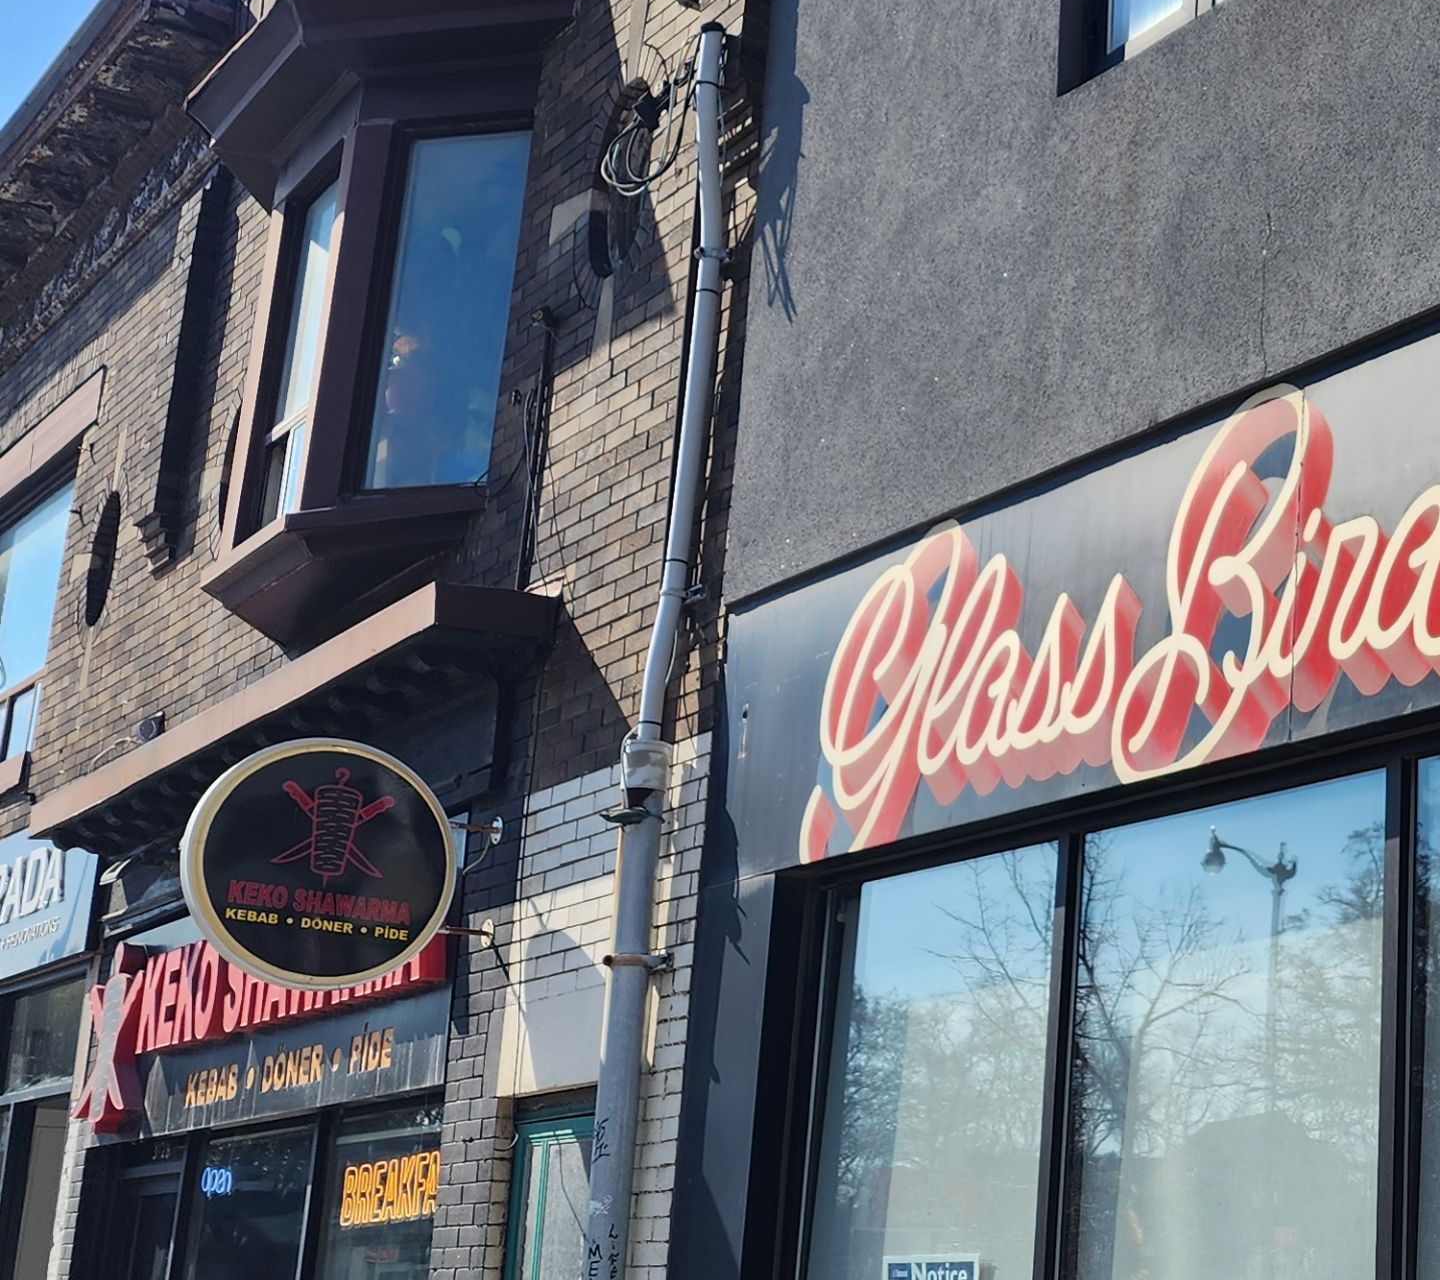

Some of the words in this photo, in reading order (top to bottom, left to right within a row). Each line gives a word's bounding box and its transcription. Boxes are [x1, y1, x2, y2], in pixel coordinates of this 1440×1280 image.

[798, 519, 1130, 864] Glass
[225, 907, 279, 924] KEBAB
[301, 915, 354, 934] DÖNER
[227, 879, 289, 908] KEKO
[292, 888, 411, 925] SHAWARMA
[134, 940, 220, 1055] KEKO
[184, 1064, 239, 1109] KEBAB
[261, 1042, 325, 1094] DÖNER
